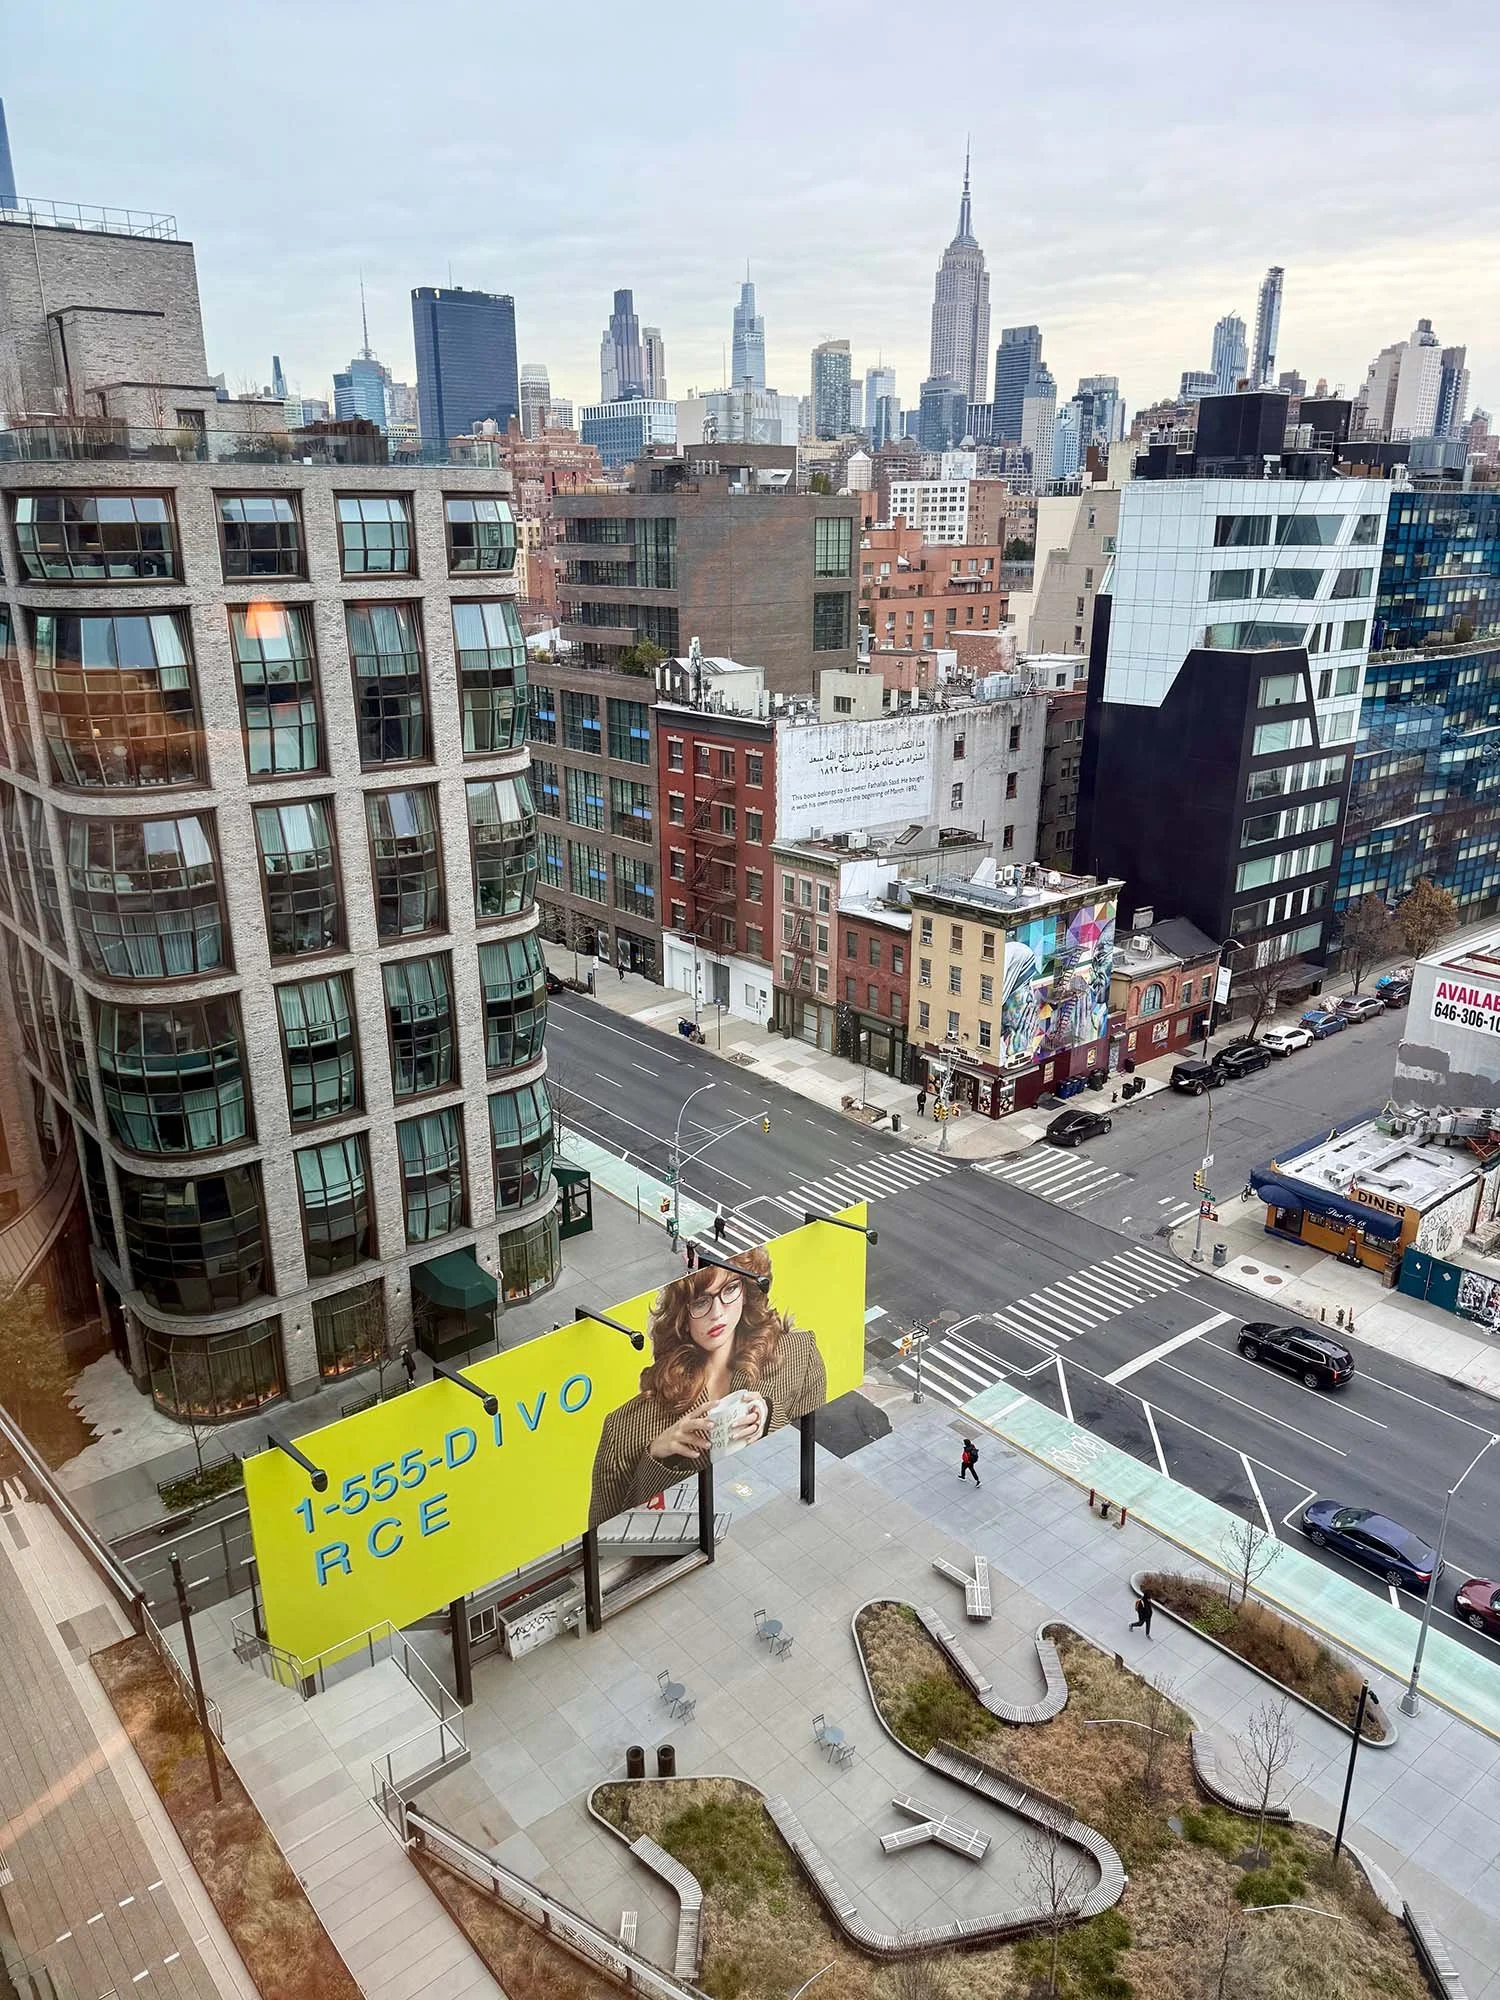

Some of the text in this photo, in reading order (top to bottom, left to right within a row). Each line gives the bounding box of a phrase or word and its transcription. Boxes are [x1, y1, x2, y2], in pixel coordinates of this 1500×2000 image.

[792, 793, 802, 801] This
[803, 791, 816, 800] book
[817, 788, 837, 798] belongs
[909, 775, 925, 783] bought
[861, 791, 884, 800] beginning
[1326, 1207, 1344, 1218] Star
[1358, 1190, 1406, 1217] DINER
[314, 1493, 450, 1587] RCE
